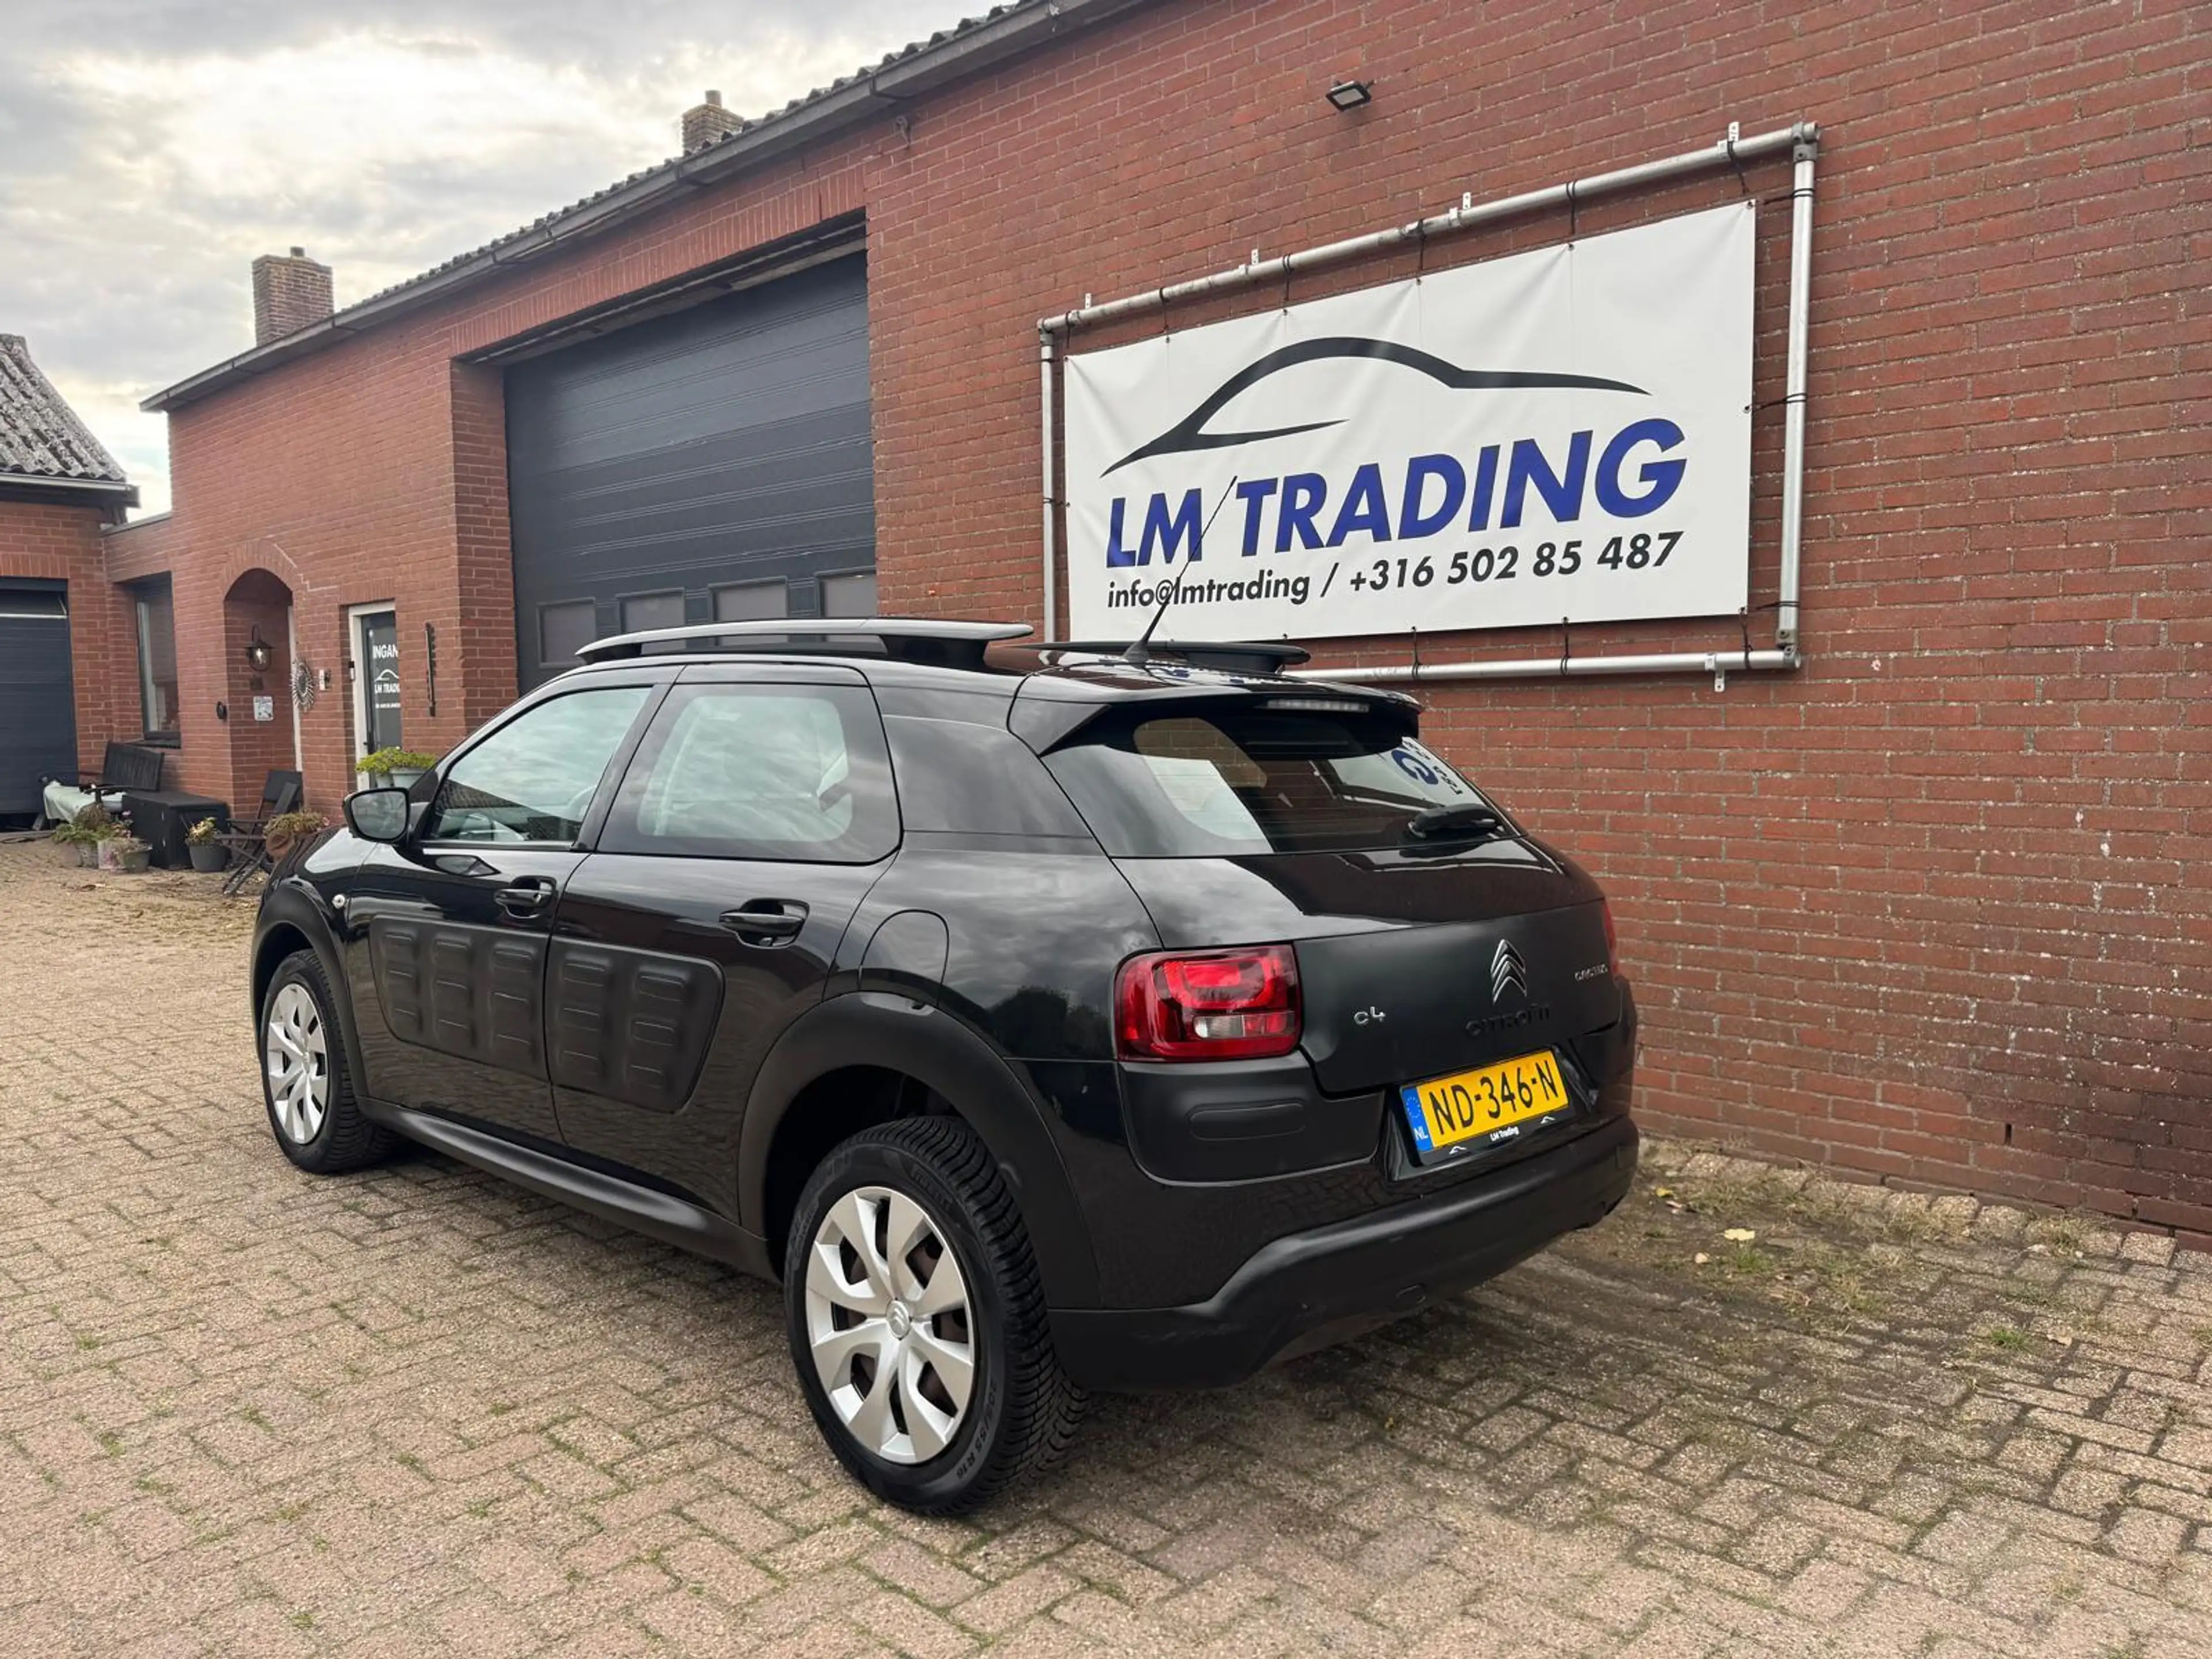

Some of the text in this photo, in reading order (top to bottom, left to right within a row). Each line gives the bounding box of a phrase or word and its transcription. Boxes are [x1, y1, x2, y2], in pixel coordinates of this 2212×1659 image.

[1106, 418, 1687, 568] LM TRADING
[1107, 531, 1684, 607] info@lmtrading / +316 502 85 487
[1354, 1006, 1386, 1025] C4
[1413, 1126, 1429, 1141] NL
[1429, 1059, 1559, 1135] ND-346-N
